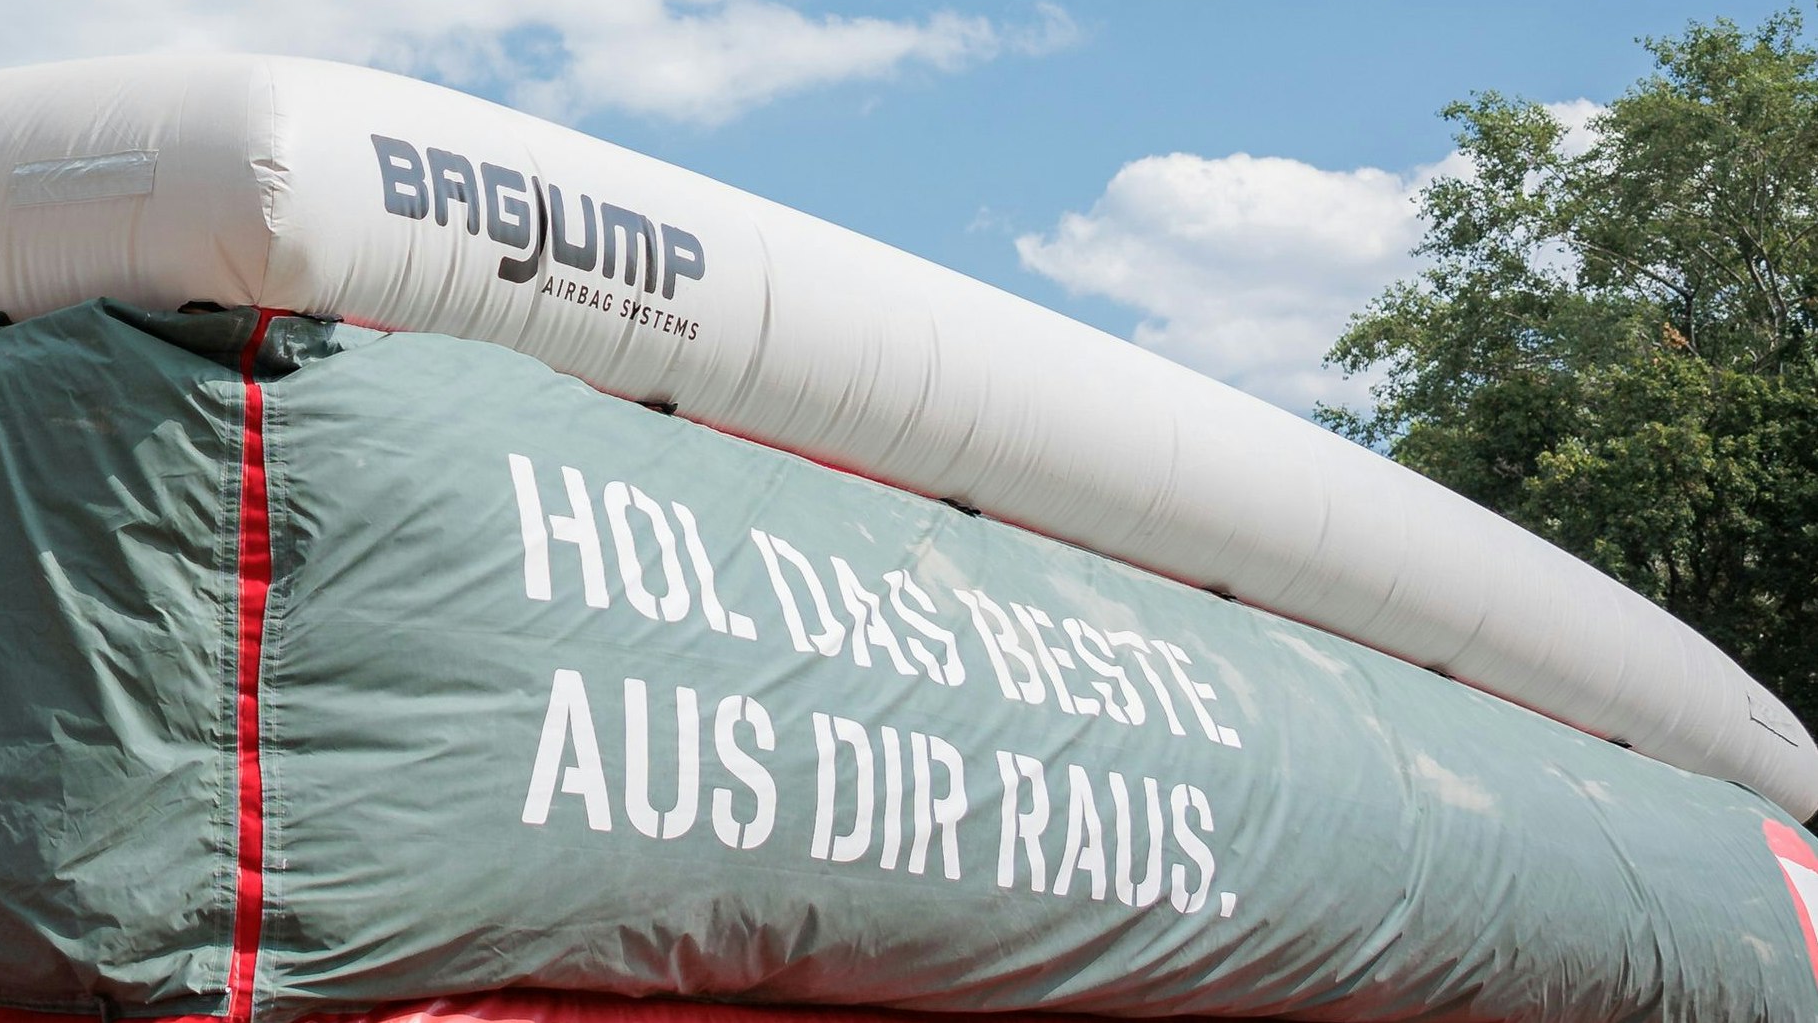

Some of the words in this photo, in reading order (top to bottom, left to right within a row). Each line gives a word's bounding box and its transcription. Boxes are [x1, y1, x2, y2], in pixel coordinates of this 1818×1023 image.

[370, 133, 706, 301] BAGJUMP
[541, 275, 613, 313] AIRBAG
[619, 297, 701, 341] SYSTEMS
[508, 453, 757, 641] HOL
[751, 527, 967, 688] DAS
[953, 588, 1243, 749] BESTE
[521, 668, 777, 850] AUS
[810, 711, 969, 881] DIR
[996, 750, 1237, 918] RAUS.
